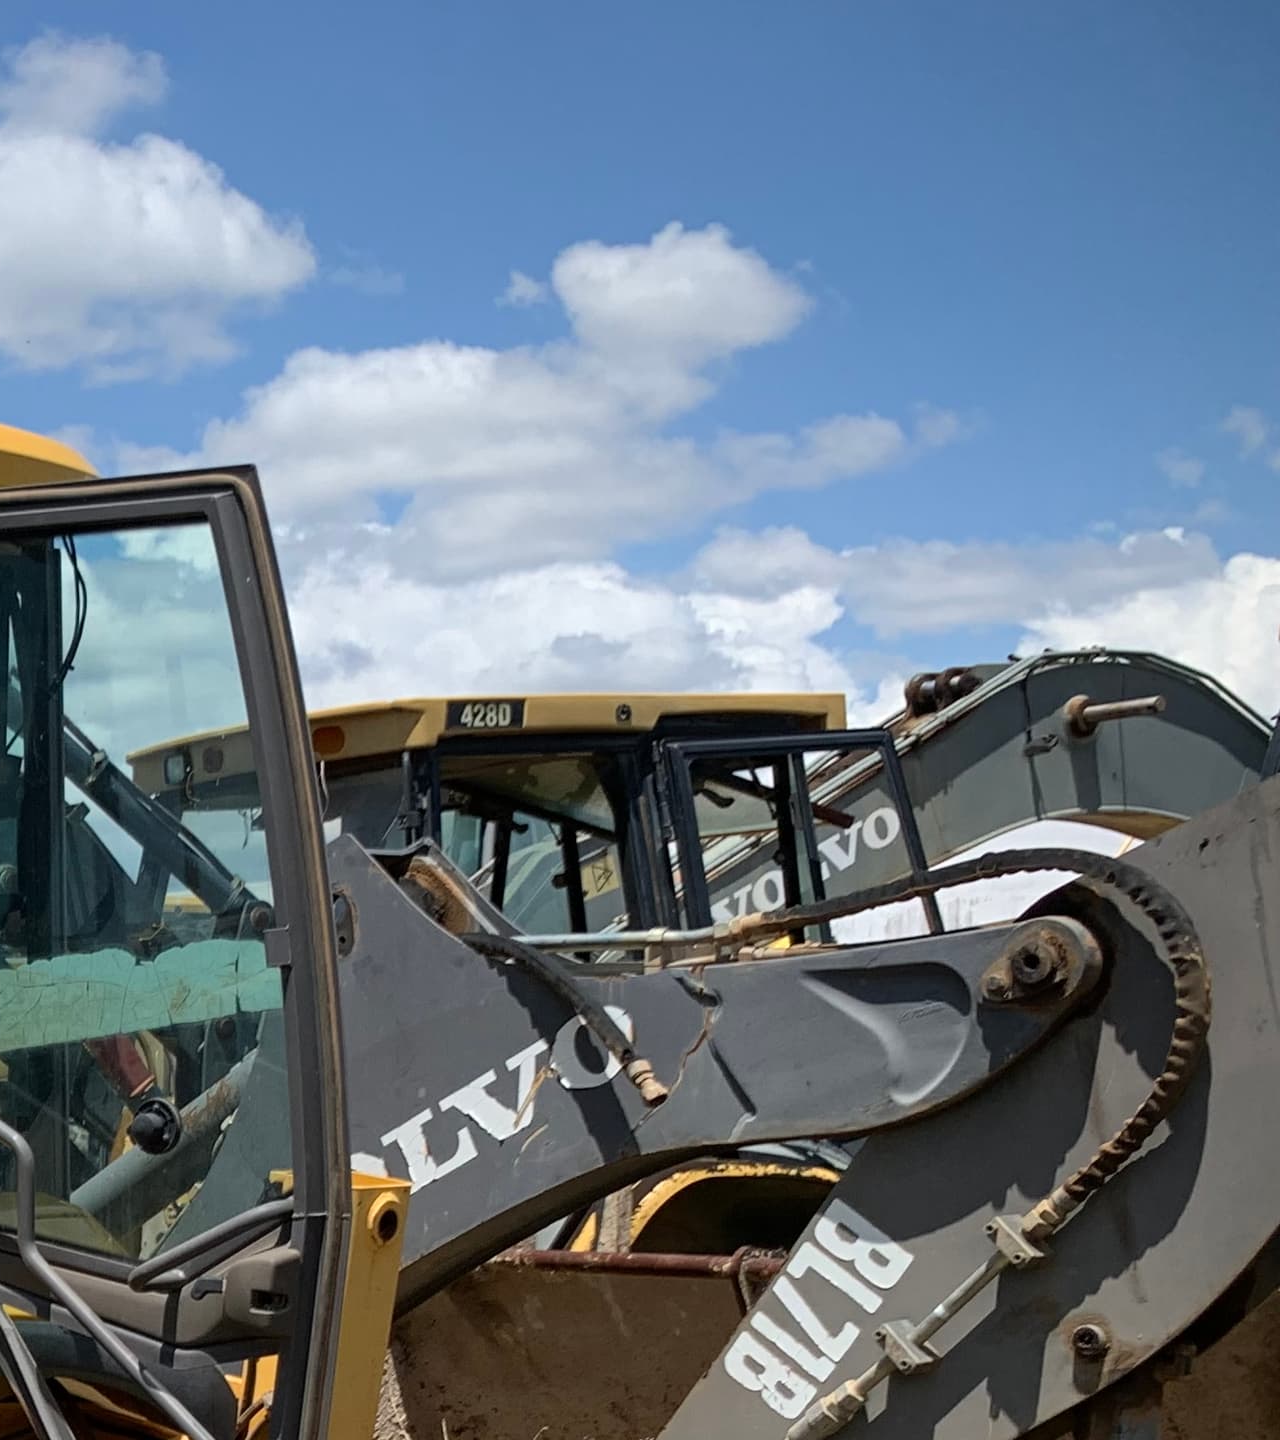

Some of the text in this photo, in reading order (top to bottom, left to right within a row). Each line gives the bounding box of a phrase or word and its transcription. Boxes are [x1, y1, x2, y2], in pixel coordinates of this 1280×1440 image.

[460, 703, 511, 728] 428D
[710, 806, 901, 926] VOVO
[350, 1004, 636, 1196] LVO
[724, 1198, 915, 1419] BL71B
